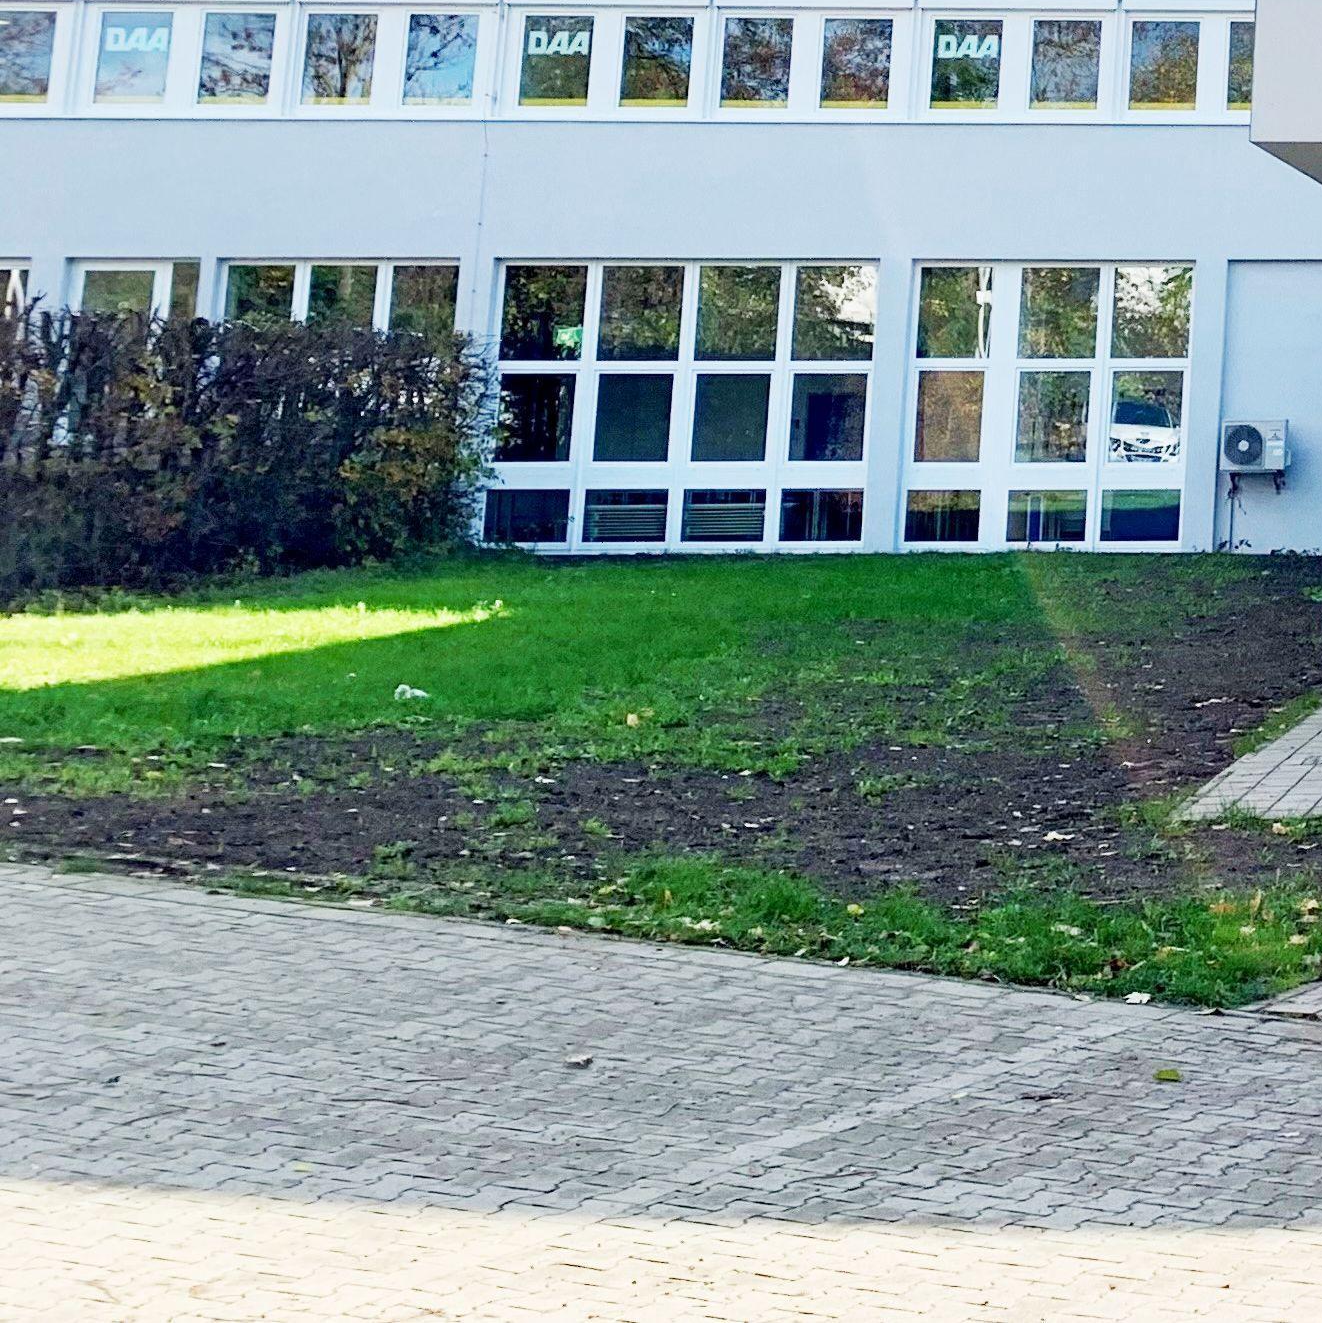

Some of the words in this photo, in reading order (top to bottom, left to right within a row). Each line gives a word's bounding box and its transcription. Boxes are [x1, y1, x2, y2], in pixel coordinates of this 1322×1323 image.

[105, 27, 169, 52] DAA
[528, 30, 591, 55] DAA
[938, 34, 1000, 59] DAA
